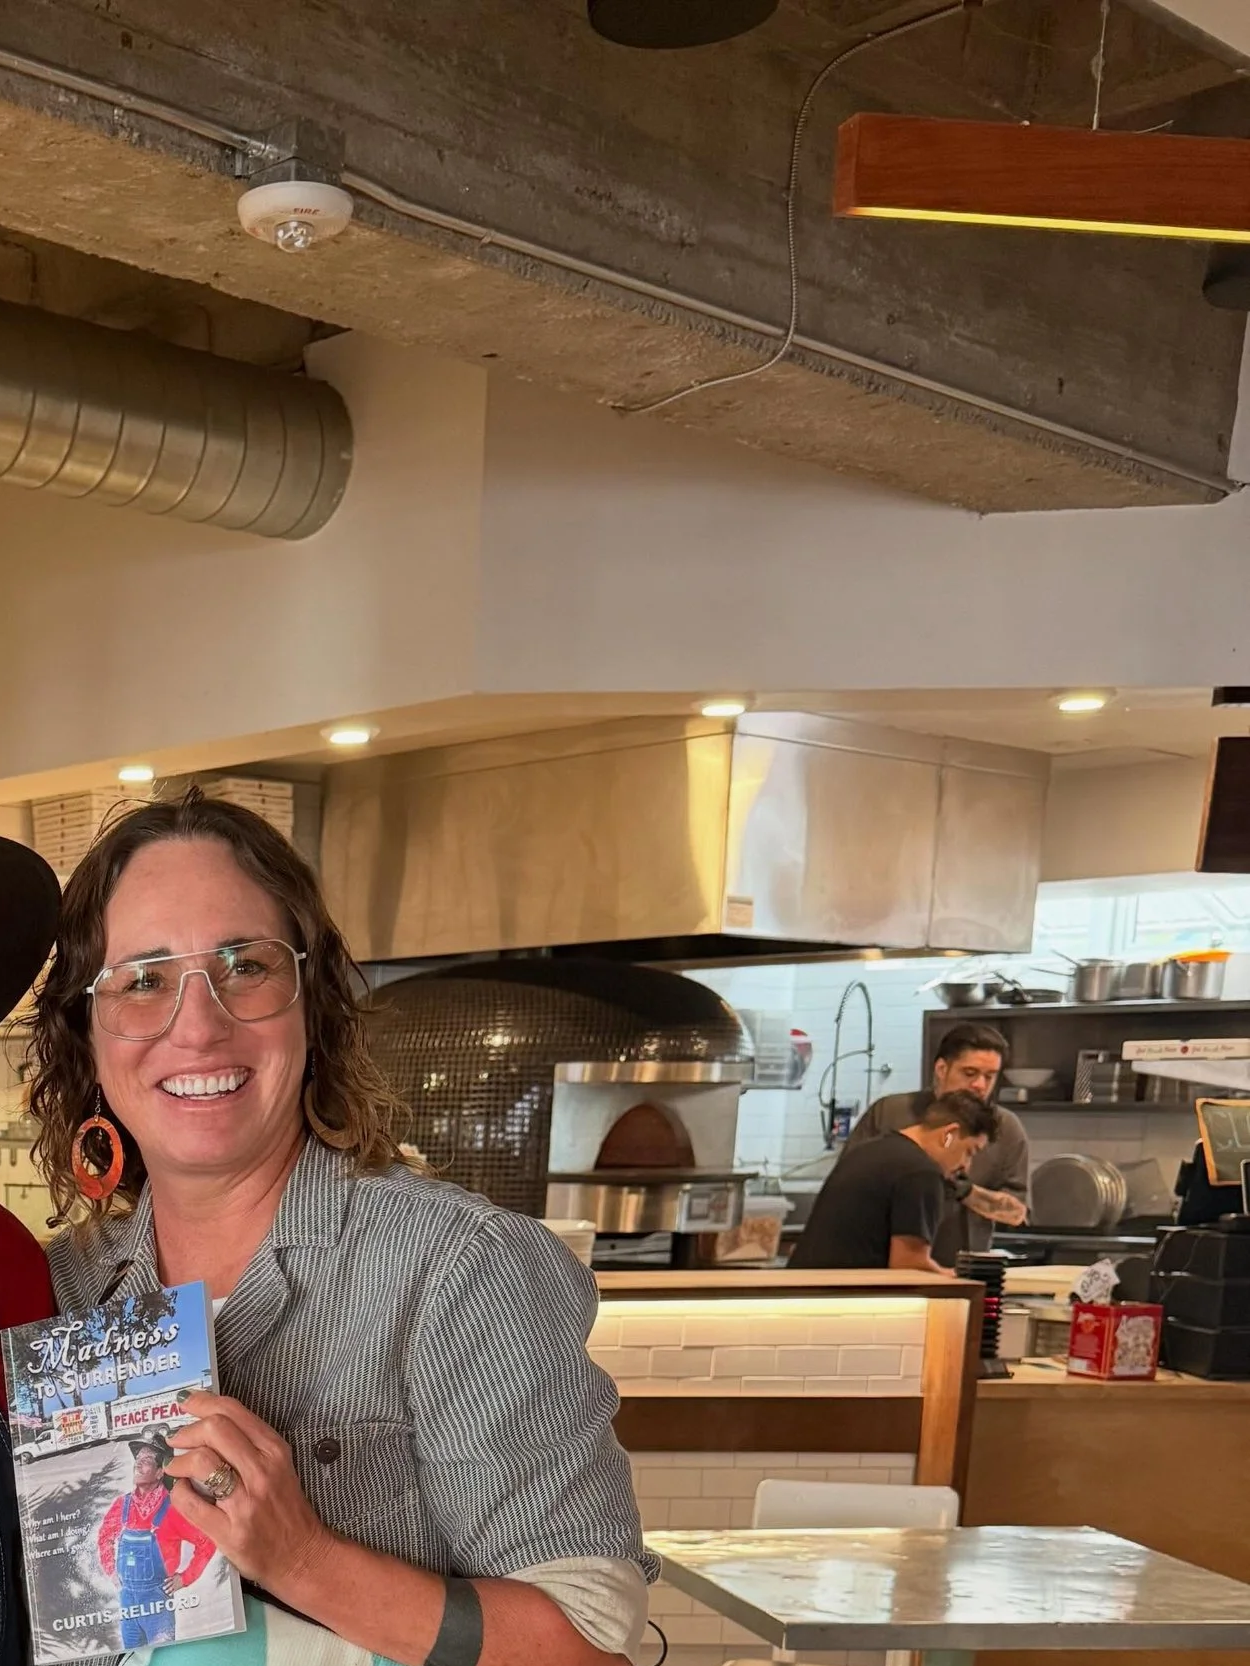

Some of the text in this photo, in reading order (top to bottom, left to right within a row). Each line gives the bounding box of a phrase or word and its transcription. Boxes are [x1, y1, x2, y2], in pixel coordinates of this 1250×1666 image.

[293, 207, 320, 216] FIRE
[27, 1320, 180, 1374] Madness
[61, 1351, 182, 1394] SURRENDER
[114, 1408, 149, 1428] PEACE
[151, 1402, 187, 1421] PEAC
[42, 1517, 54, 1526] am
[60, 1509, 81, 1521] here?
[47, 1532, 59, 1540] am
[52, 1547, 64, 1555] am
[52, 1594, 201, 1632] CURTIS RELIFORD
